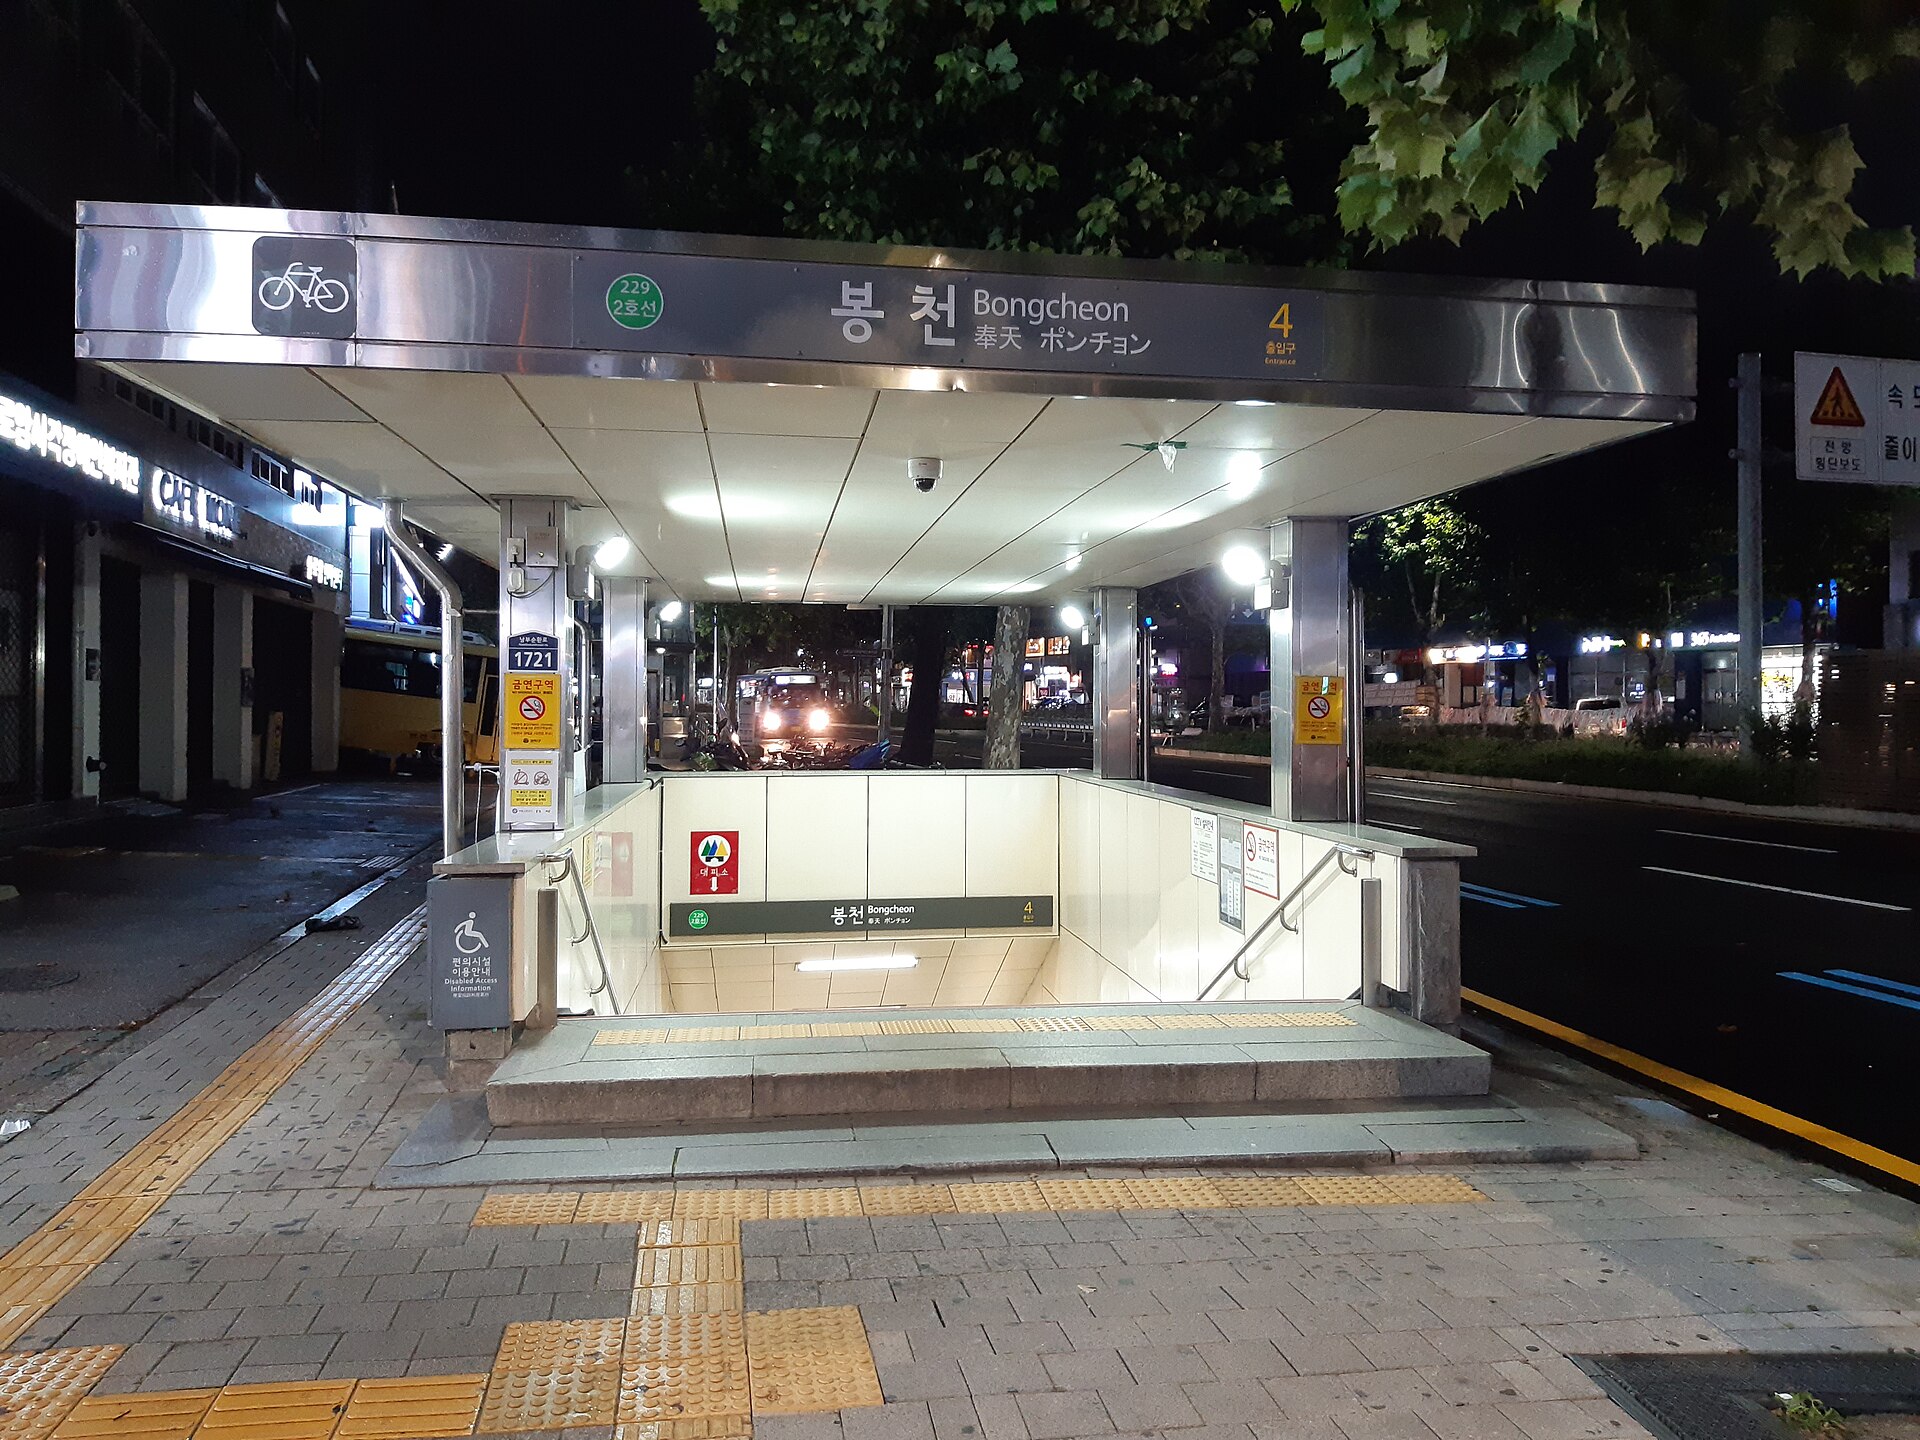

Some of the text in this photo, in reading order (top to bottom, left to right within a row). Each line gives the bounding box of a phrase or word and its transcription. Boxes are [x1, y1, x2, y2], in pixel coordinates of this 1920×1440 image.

[619, 280, 650, 295] 229
[612, 297, 657, 319] 2호선
[973, 289, 1130, 325] Bongcheon
[1268, 303, 1294, 339] 4
[973, 324, 1153, 358] 奉天 ポンチョン
[1265, 340, 1297, 355] 출입구
[1264, 357, 1297, 365] Entrance
[1815, 457, 1861, 472] 횡단보도
[514, 651, 552, 668] 1721
[512, 679, 554, 691] 금연구역
[1302, 681, 1337, 692] 금연역
[700, 867, 729, 877] 대피소
[867, 904, 915, 916] Bongcheon
[1023, 901, 1033, 914] 4
[831, 905, 864, 926] 봉천
[884, 917, 911, 925] ポンチョン
[452, 956, 491, 967] 편의시설
[452, 967, 491, 977] 이용안내
